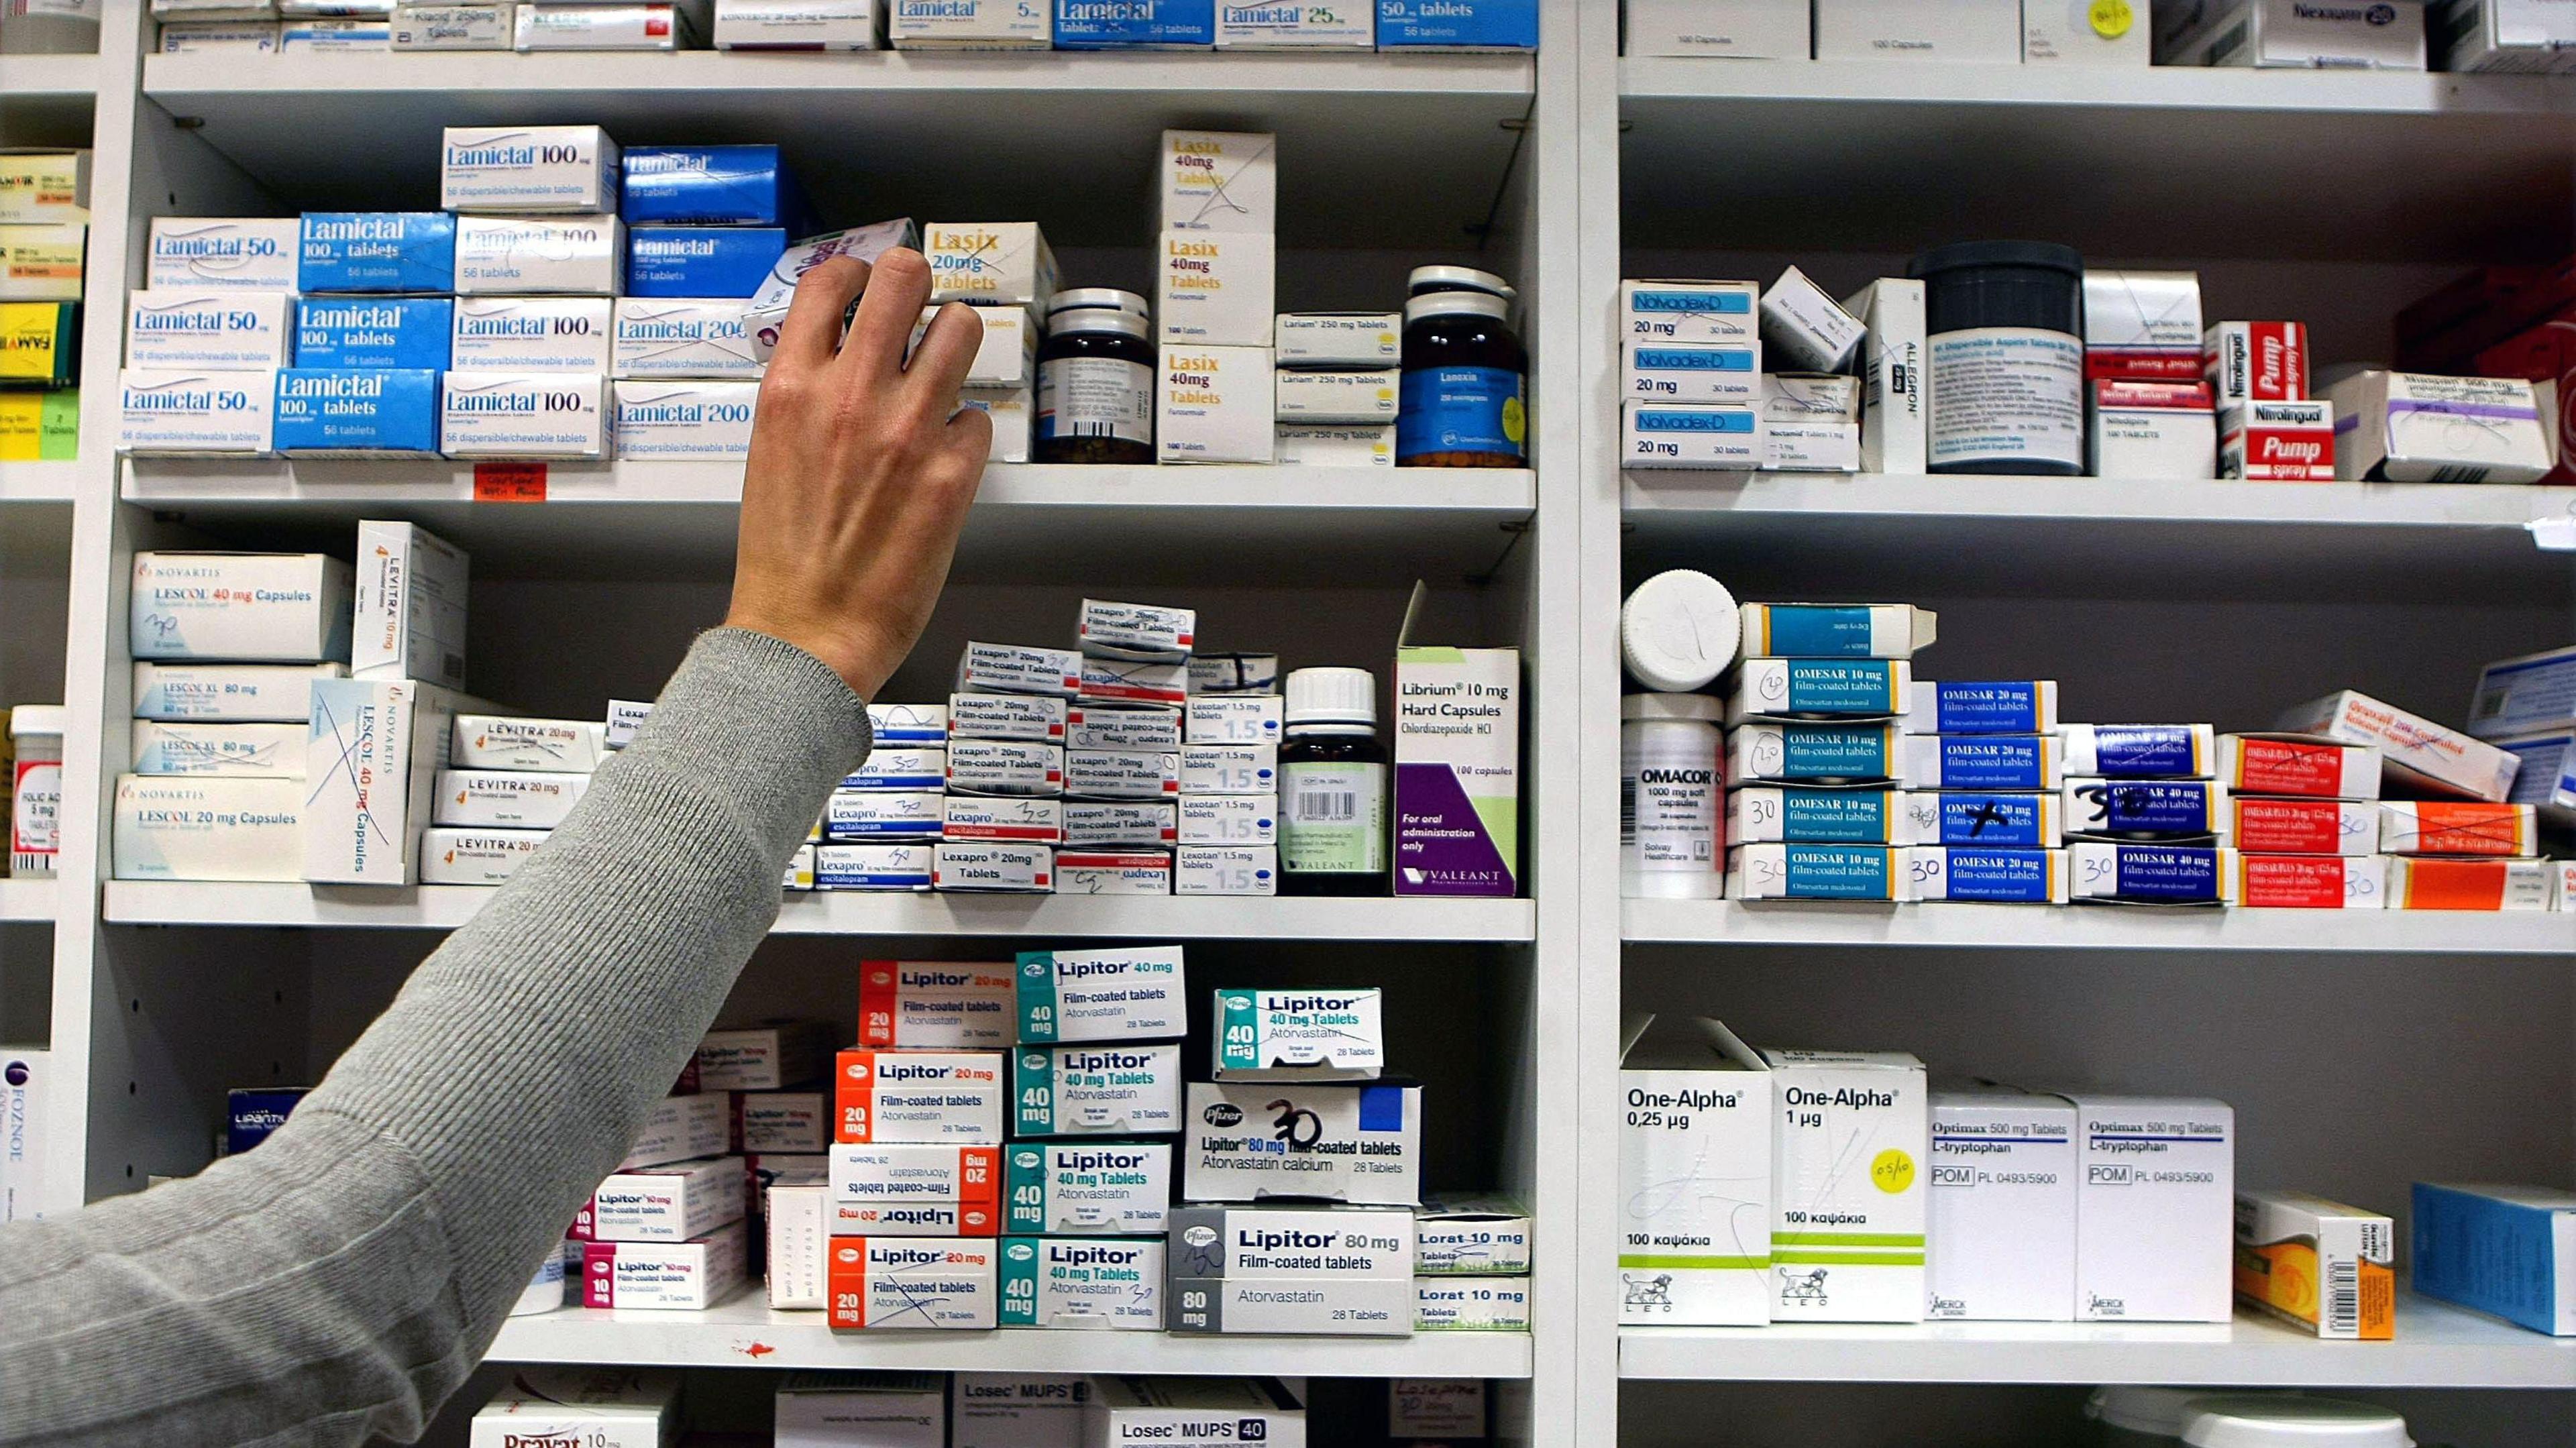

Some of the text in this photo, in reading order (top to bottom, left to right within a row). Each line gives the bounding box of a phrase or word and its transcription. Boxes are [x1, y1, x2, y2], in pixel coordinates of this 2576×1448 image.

[1308, 9, 1334, 23] 25
[1381, 1, 1473, 17] 50 tablets
[1403, 26, 1457, 37] 56 tablets
[541, 146, 578, 164] 100
[303, 218, 404, 240] Lamictal
[933, 231, 998, 251] Lasix
[1169, 239, 1219, 256] Lasix
[304, 242, 400, 258] 100 tablets
[932, 254, 983, 273] 20mg
[1170, 258, 1210, 272] 40mg
[933, 275, 997, 290] Tablets
[1169, 275, 1221, 290] Tablets
[134, 311, 257, 330] Lamictal 50
[1320, 320, 1338, 329] 250
[1339, 321, 1354, 331] mg
[1356, 319, 1389, 329] Tablets
[1907, 341, 1918, 412] ALLEGRON
[446, 392, 580, 412] Lamictal 100
[618, 404, 749, 422] Lamictal 200
[2255, 406, 2322, 423] Nitrolingual
[1638, 414, 1725, 430] Nolvadex-D
[1638, 440, 1654, 453] 20
[1656, 441, 1678, 455] mg
[1725, 446, 1750, 454] tablets
[2262, 436, 2321, 463] Pump
[156, 568, 221, 577] NOVARTIS
[154, 588, 312, 603] LESCOL 40 mg Capsules
[1794, 669, 1882, 682] OMESAR 10 mg
[1402, 682, 1509, 700] Librium 10 mg
[1795, 681, 1882, 691] film-coated tablets
[1191, 702, 1228, 711] Lexotan
[1246, 704, 1260, 712] mg
[1402, 704, 1501, 719] Hard Capsules
[1191, 712, 1222, 720] Tablets
[1401, 722, 1473, 737] Chlordiazepoxide
[953, 748, 1026, 759] Lexapro 20mg
[952, 758, 1043, 769] Film-coated Tablets
[1457, 765, 1513, 777] 100 capsules
[1642, 769, 1711, 785] OMACOR
[468, 779, 559, 794] LEVITRA 20 mg
[1648, 788, 1705, 799] 1000 mg soft
[1658, 798, 1699, 807] capsules
[833, 808, 877, 821] Lexapro
[1402, 814, 1442, 824] For oral
[1751, 800, 1775, 824] 30
[833, 821, 881, 831] escitalopram
[1402, 828, 1475, 838] administration
[1402, 842, 1424, 852] only
[1644, 843, 1671, 853] Solvay
[1644, 852, 1688, 862] Healthcare
[2124, 852, 2210, 867] OMESAR 40 mg
[1429, 870, 1501, 880] VALEANT
[1912, 859, 1940, 882] 30
[1064, 1053, 1150, 1070] Lipitor
[879, 1065, 993, 1081] Lipitor 20 mg
[1065, 1072, 1155, 1087] 40 mg Tablets
[880, 1095, 982, 1106] Film-coated tablets
[1065, 1088, 1138, 1101] Atorvastatin
[1627, 1089, 1737, 1109] One-Alpha
[1786, 1088, 1893, 1109] One-Alpha
[881, 1109, 942, 1121] Atorvastatin
[1205, 1105, 1242, 1127] Pfizer
[1627, 1112, 1662, 1126] 0,25
[1786, 1111, 1794, 1123] 1
[1266, 1098, 1323, 1148] 30
[1932, 1122, 2067, 1136] Optimax 500 mg Tablets
[1201, 1137, 1285, 1155] Lipitor 80 mg
[1932, 1142, 2012, 1154] L-tryptophan
[1201, 1156, 1333, 1172] Atorvastatin calcium
[1934, 1168, 2057, 1184] POM PL 0493/5900
[849, 1182, 951, 1195] Film-coated tablets
[883, 1210, 953, 1225] Lipitor
[1239, 1231, 1399, 1251] Lipitor 80 mg
[1627, 1233, 1711, 1247] 100 καψάκια
[1239, 1254, 1373, 1269] Film-coated tablets
[1238, 1289, 1325, 1303] Atorvastatin
[1419, 1289, 1524, 1302] Lorat 10 mg
[1332, 1309, 1389, 1321] 28 Tablets
[1122, 1422, 1262, 1438] Losec MUPS 40
